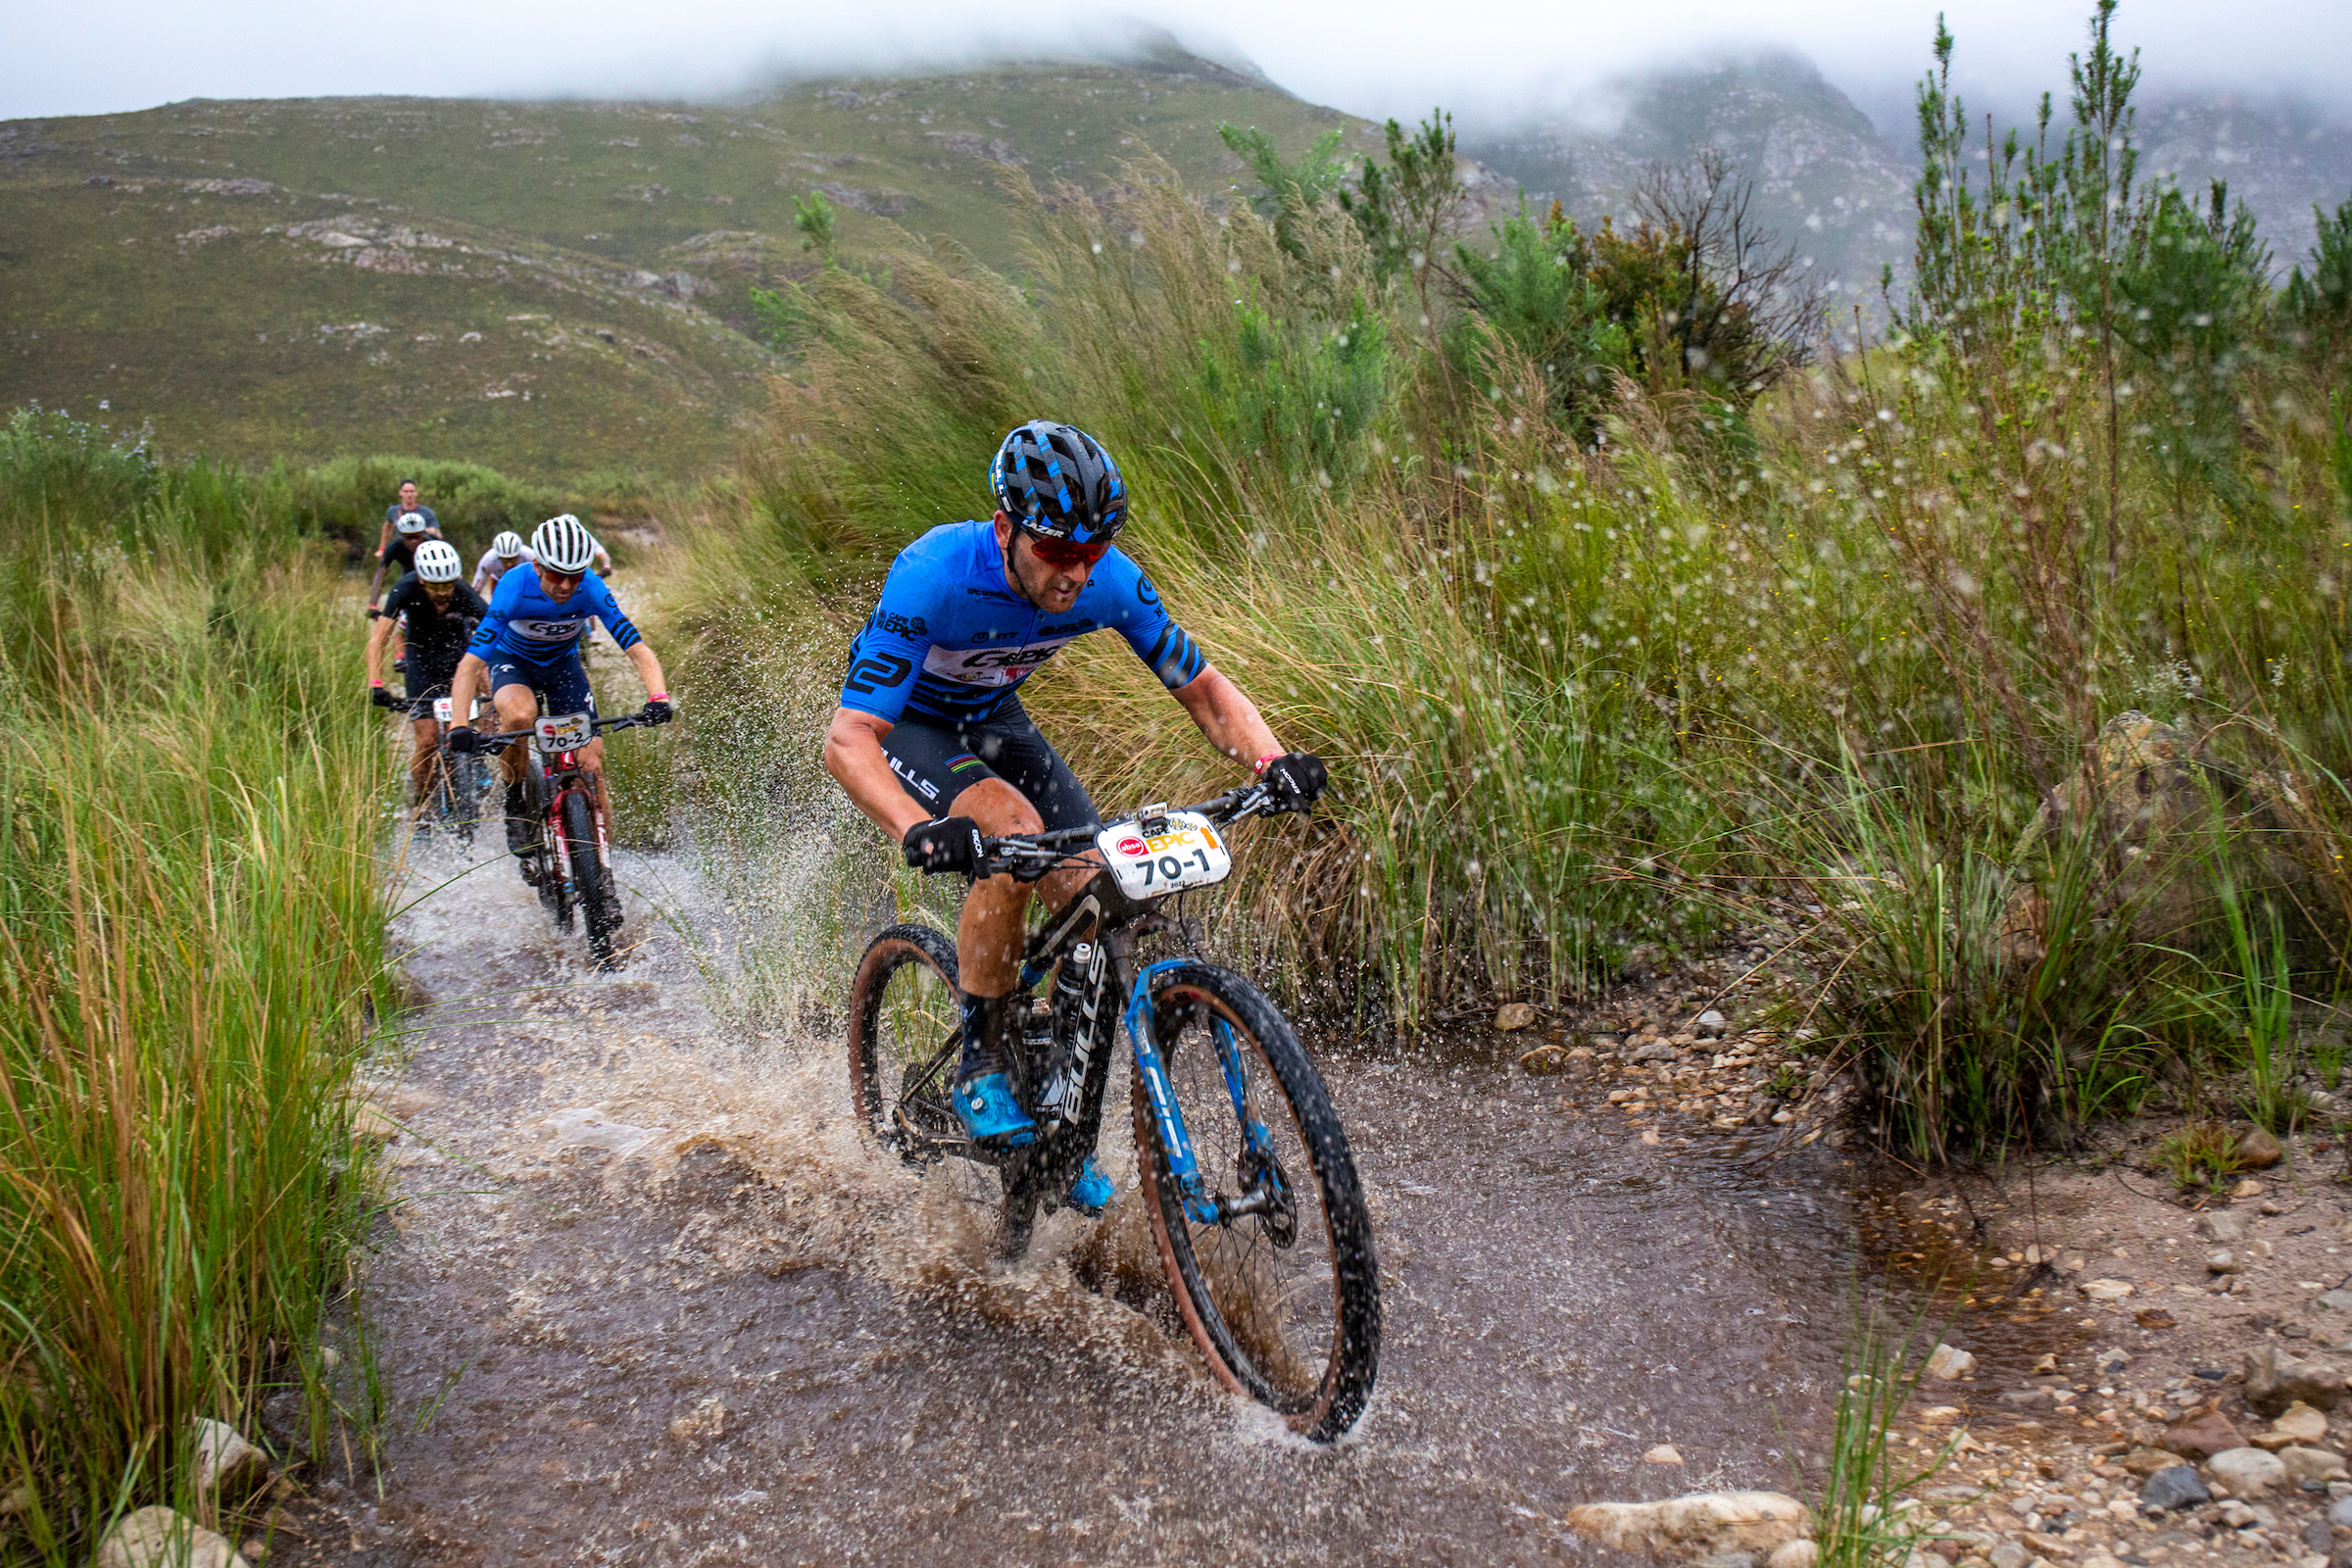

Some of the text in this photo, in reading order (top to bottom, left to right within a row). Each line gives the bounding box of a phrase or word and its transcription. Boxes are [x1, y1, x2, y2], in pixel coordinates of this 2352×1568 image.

[1022, 517, 1065, 538] LAZER
[889, 612, 909, 625] CAPE
[883, 619, 919, 642] EPIC
[547, 732, 583, 748] 70-2
[1279, 767, 1301, 794] ERGON
[971, 828, 984, 858] ERGON
[1142, 826, 1171, 839] CAPE
[1146, 831, 1196, 853] EPIC
[1121, 840, 1141, 852] absa
[1135, 849, 1210, 886] 70-1
[1064, 938, 1107, 1125] BULLS
